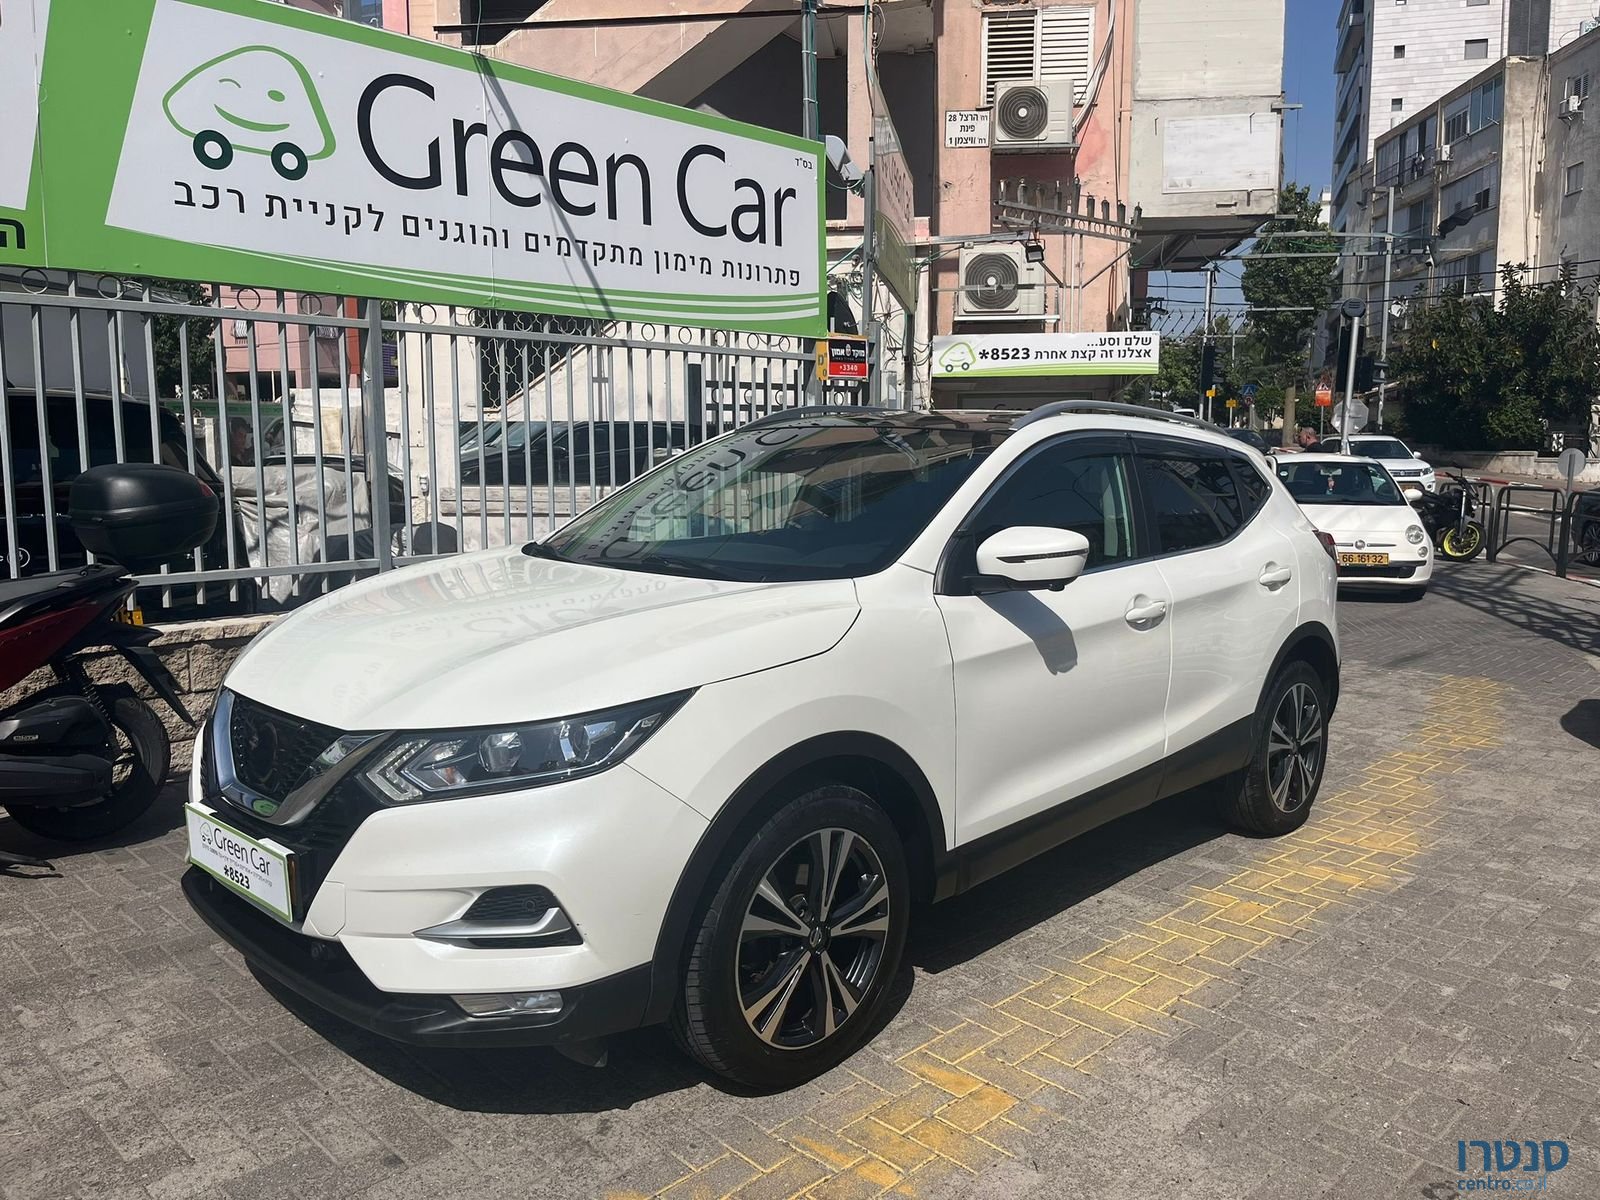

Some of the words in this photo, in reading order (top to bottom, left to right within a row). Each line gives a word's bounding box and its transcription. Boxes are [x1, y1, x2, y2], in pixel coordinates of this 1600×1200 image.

[948, 114, 957, 122] 28
[959, 112, 978, 121] הרצל
[959, 124, 976, 132] פינת
[357, 73, 652, 226] Green
[677, 144, 797, 247] Car
[795, 158, 813, 169] בס"ד
[174, 181, 245, 213] רכב
[264, 194, 385, 235] לקניית
[402, 215, 509, 249] והוגנים
[524, 232, 643, 267] מתקדמים
[654, 250, 712, 275] מימון
[721, 260, 800, 287] פתרונות
[1087, 337, 1120, 346] וסע...
[1124, 335, 1152, 346] שלם
[1034, 350, 1067, 360] אחרת
[1071, 349, 1096, 361] קצת
[1100, 349, 1114, 358] זה
[1117, 347, 1152, 358] אצלנו
[214, 828, 249, 864] Green
[250, 847, 271, 876] Car
